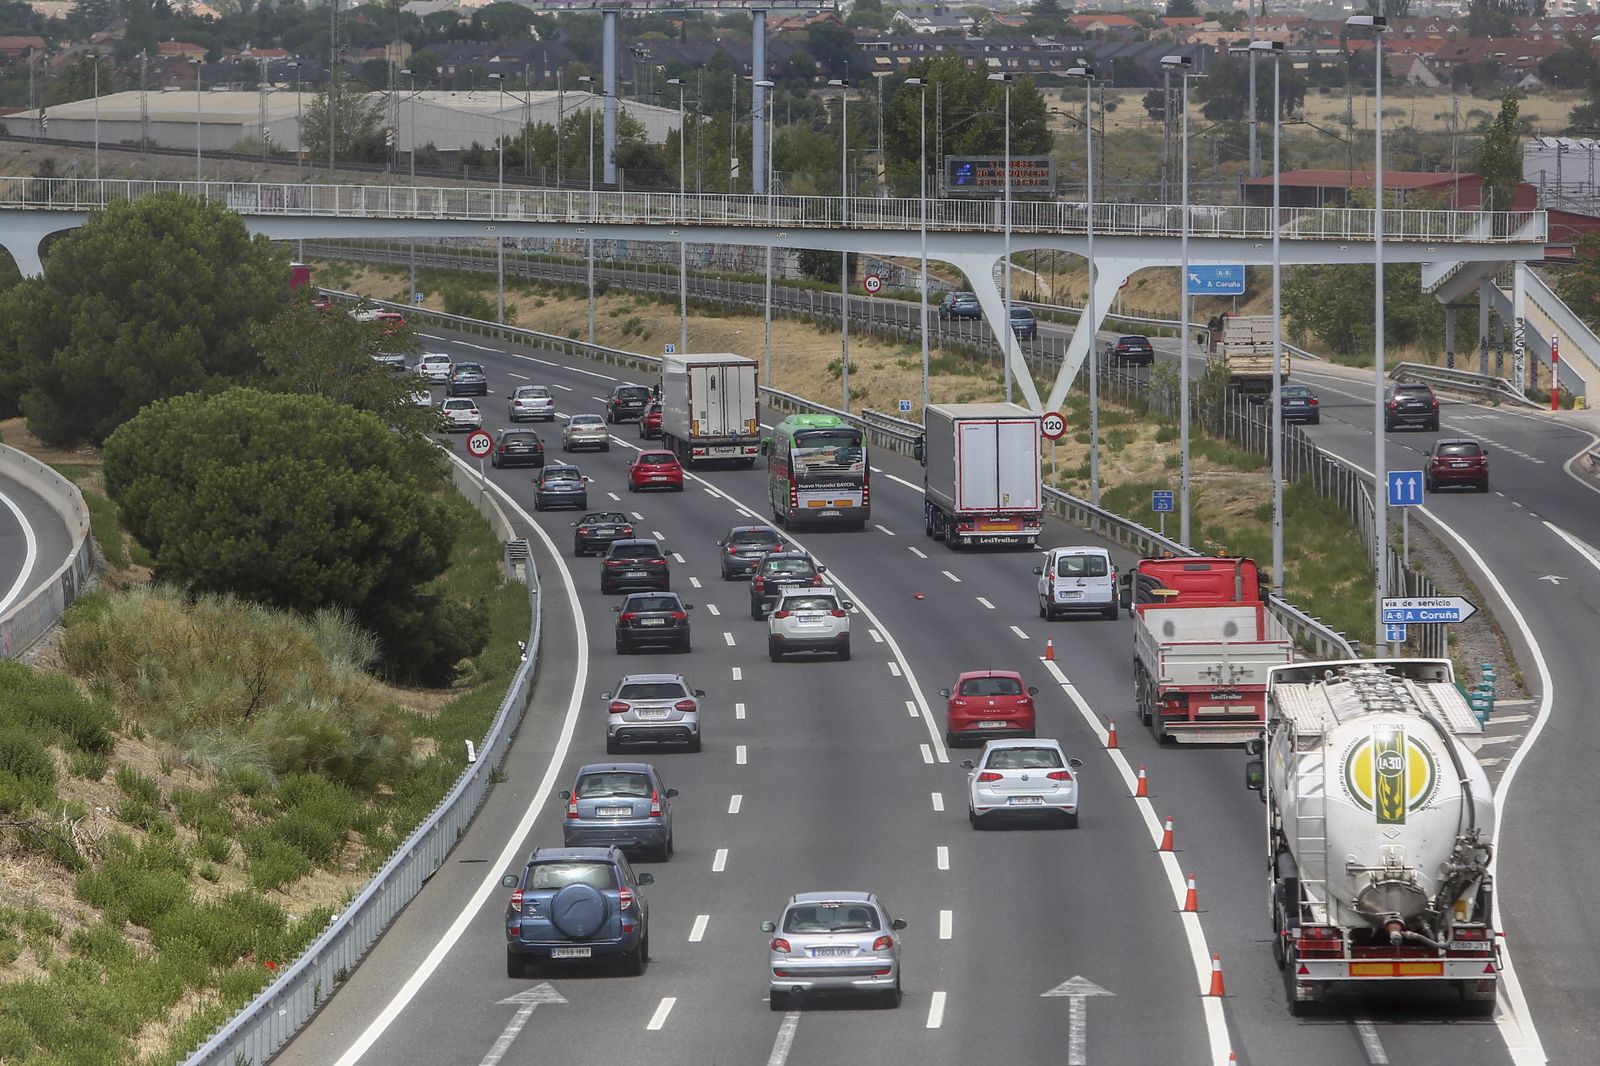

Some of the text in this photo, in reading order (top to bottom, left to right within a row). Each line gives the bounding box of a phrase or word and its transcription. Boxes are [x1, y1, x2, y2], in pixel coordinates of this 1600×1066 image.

[867, 280, 879, 288] 60
[1215, 280, 1241, 288] Coruña
[1044, 421, 1062, 430] 120
[471, 438, 489, 449] 120
[1402, 599, 1413, 607] de
[1417, 599, 1451, 607] servicio
[1405, 611, 1414, 619] A
[1419, 610, 1459, 620] Coruña
